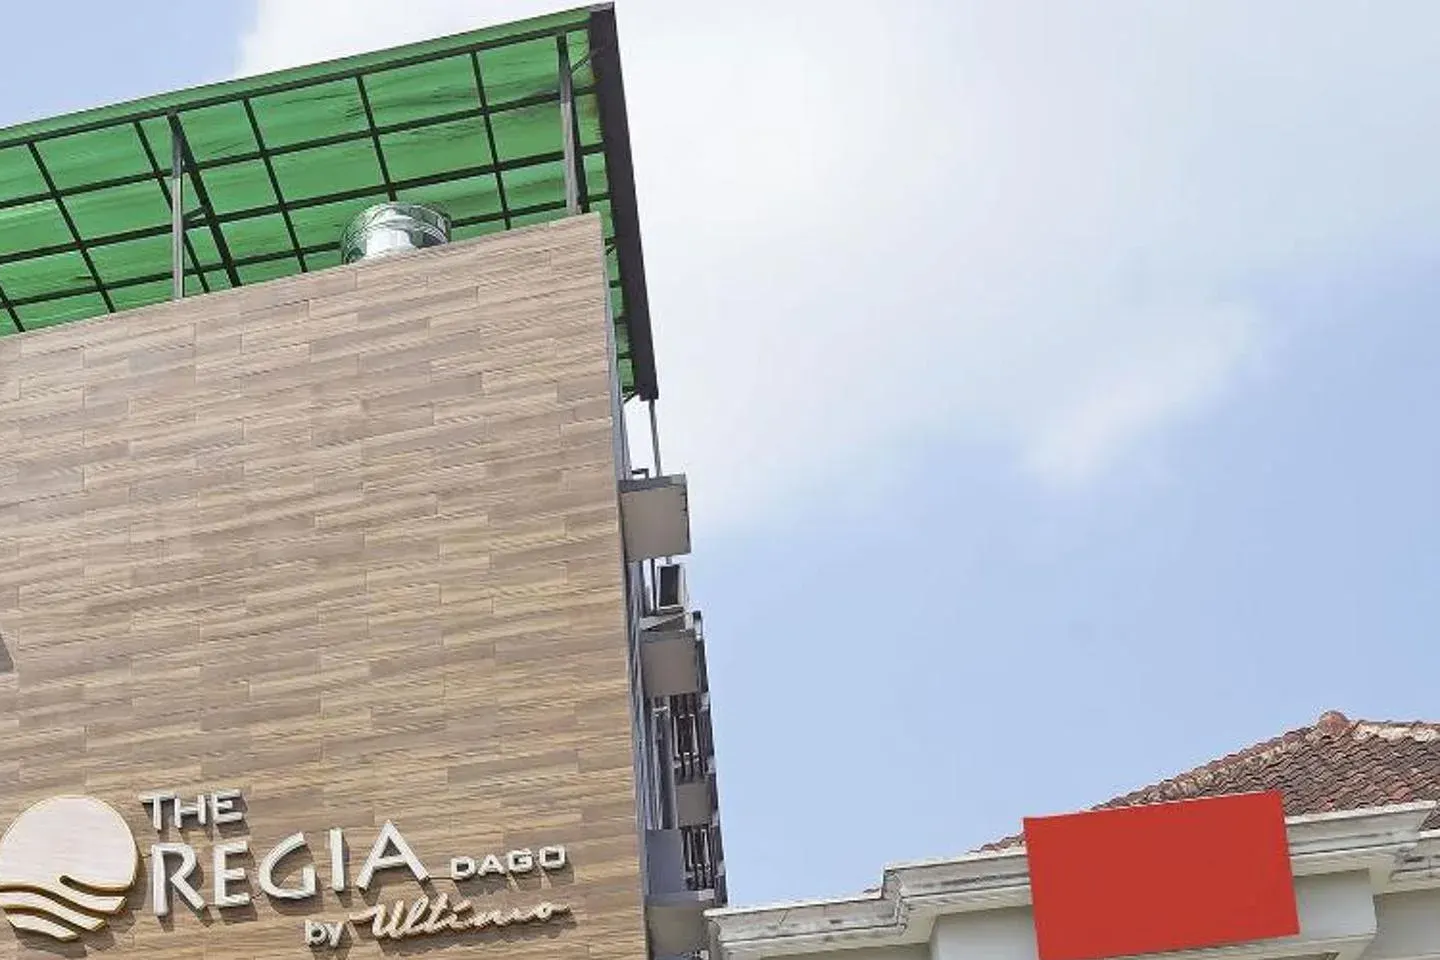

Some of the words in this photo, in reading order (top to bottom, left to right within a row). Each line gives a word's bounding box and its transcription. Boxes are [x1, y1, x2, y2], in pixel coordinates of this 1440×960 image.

[138, 788, 243, 830] THE
[150, 819, 430, 917] REGIA
[450, 845, 566, 881] DAGO
[304, 918, 344, 947] by
